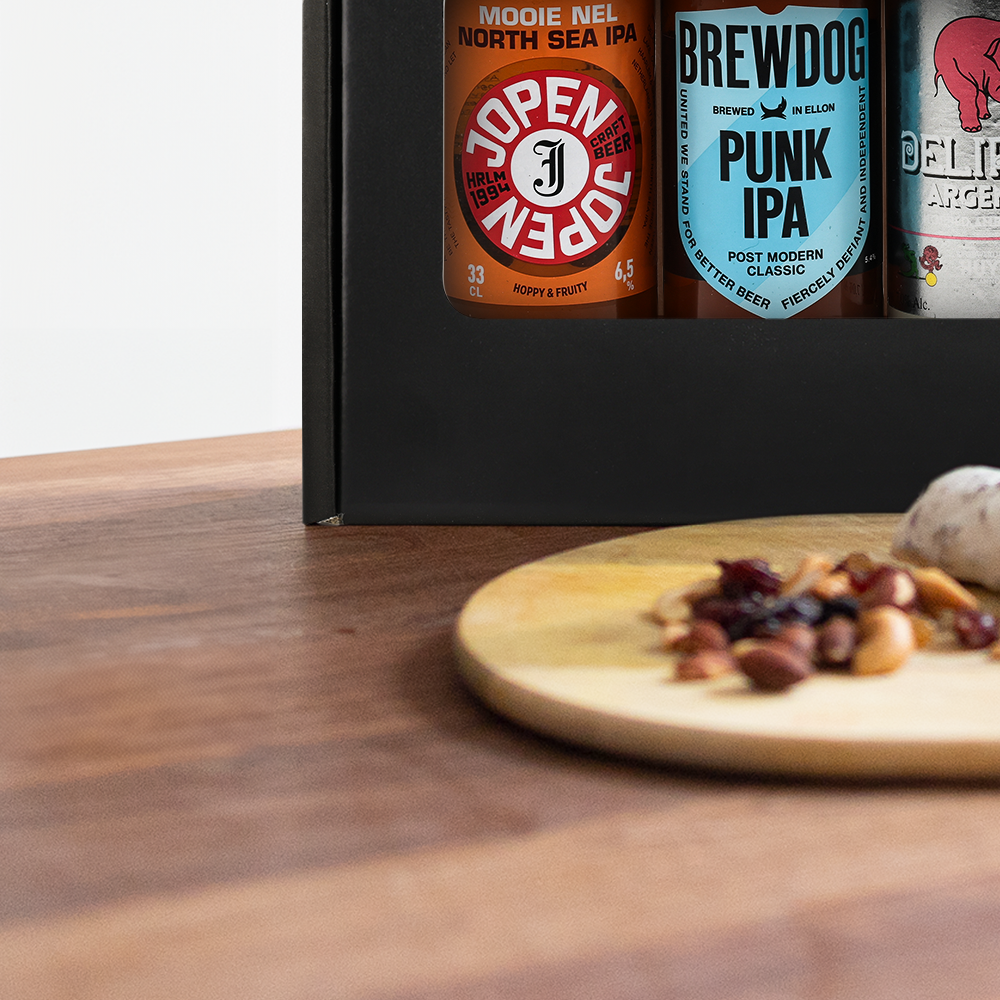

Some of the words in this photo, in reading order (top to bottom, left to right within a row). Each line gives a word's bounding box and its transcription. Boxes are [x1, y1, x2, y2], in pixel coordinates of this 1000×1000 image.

[479, 5, 562, 27] MOOIE
[571, 3, 618, 26] NEL
[458, 26, 538, 50] NORTH
[548, 28, 598, 50] SEA
[606, 23, 637, 46] IPA
[679, 16, 865, 89] BREWDOG
[466, 76, 618, 168] JOPEN
[679, 88, 689, 140] UNITED
[713, 105, 755, 116] BREWED
[792, 105, 803, 115] IN
[804, 103, 835, 115] ELLON
[590, 114, 627, 148] CRAFT
[594, 132, 632, 160] BEER
[680, 144, 689, 165] WE
[719, 127, 832, 183] PUNK
[466, 171, 506, 189] HRLM
[681, 170, 689, 215] STAND
[470, 182, 511, 209] 1994
[780, 267, 836, 310] FIERCELY
[835, 217, 866, 271] DEFIANT
[858, 85, 867, 182] INDEPENDENT
[481, 162, 632, 260] JOPEN
[743, 186, 810, 239] IPA
[682, 220, 697, 249] FOR
[728, 251, 763, 262] POST
[767, 248, 824, 262] MODERN
[467, 263, 485, 285] 33
[614, 258, 634, 283] 6,5
[694, 248, 736, 291] BETTER
[746, 264, 806, 277] CLASSIC
[469, 286, 483, 298] CL
[513, 283, 546, 298] HOPPY
[547, 289, 554, 298] &
[556, 281, 588, 298] FRUITY
[626, 281, 634, 291] %
[735, 285, 771, 310] BEER
[912, 297, 930, 311] Alc.
